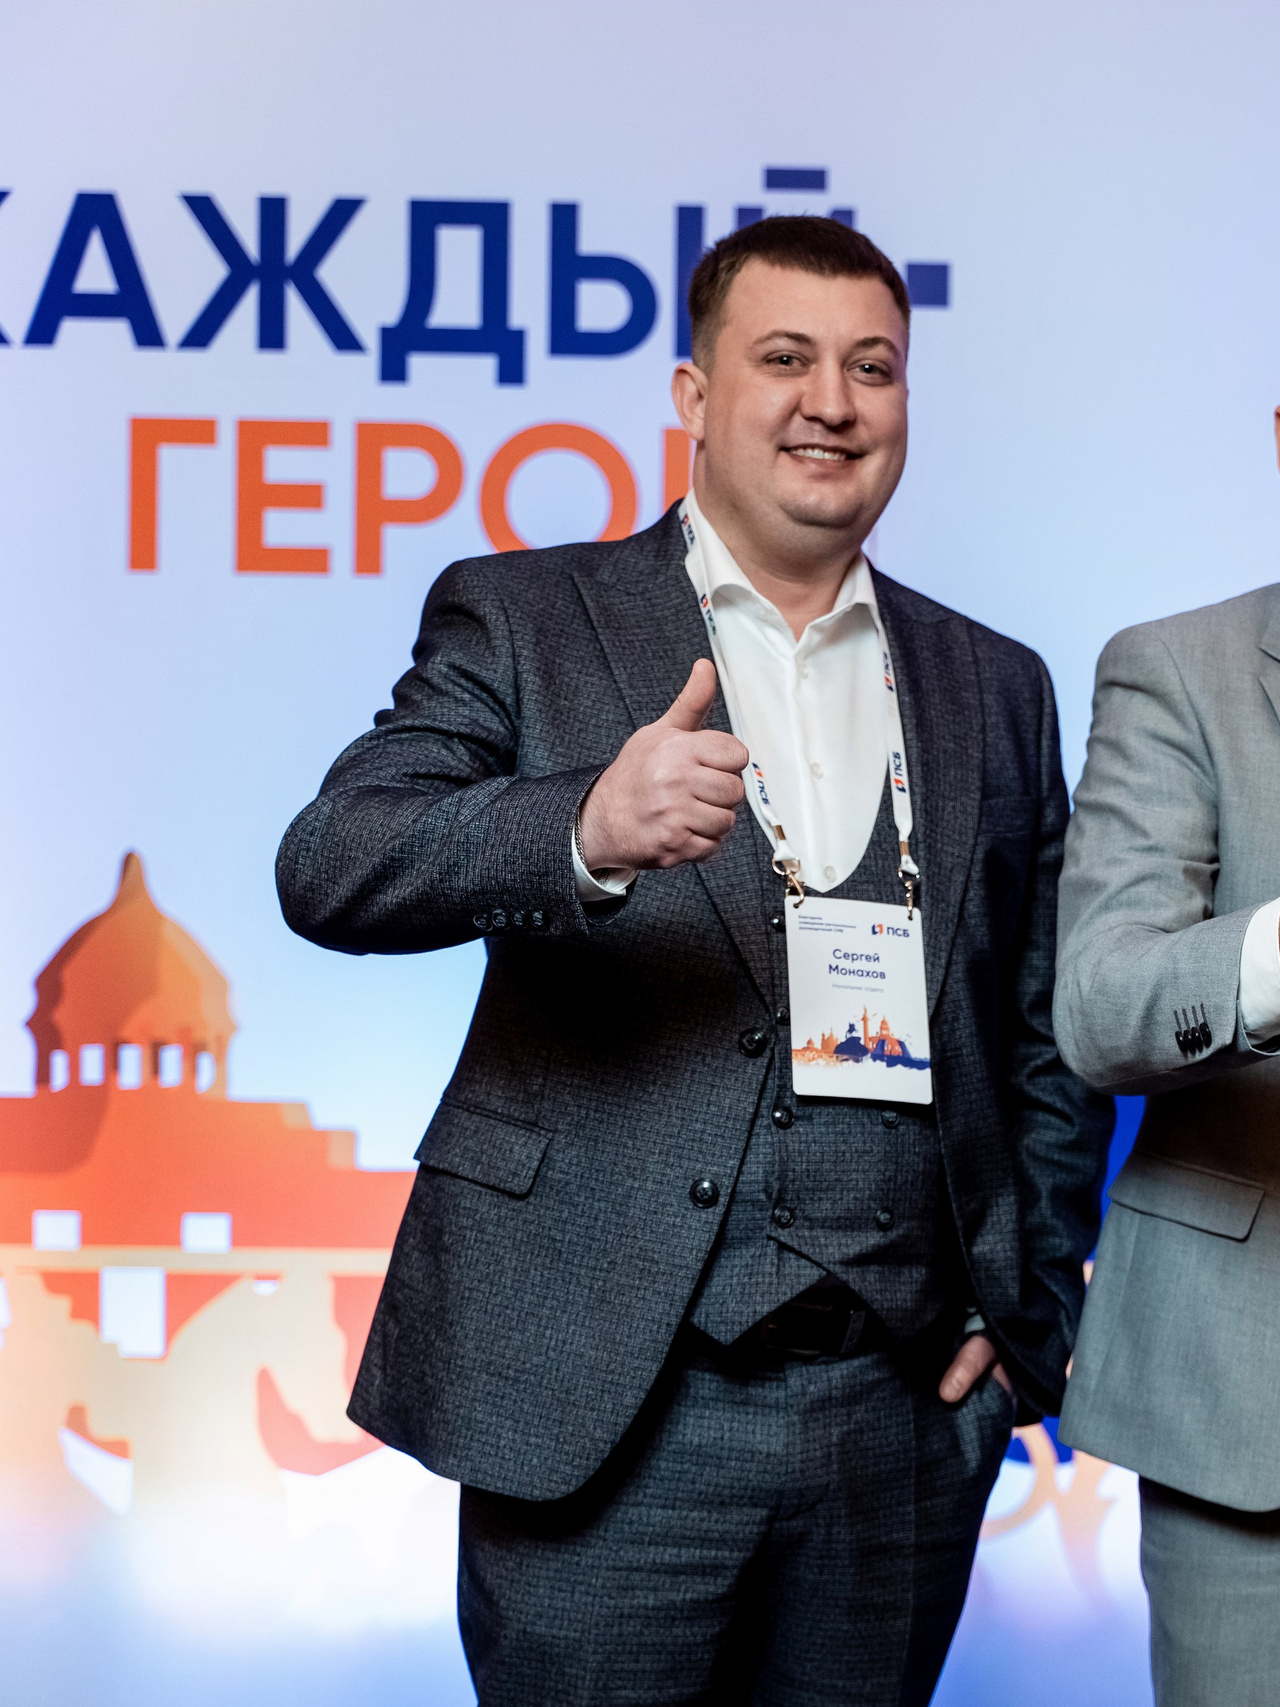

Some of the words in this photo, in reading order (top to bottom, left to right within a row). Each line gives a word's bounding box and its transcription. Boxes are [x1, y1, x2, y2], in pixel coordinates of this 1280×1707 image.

[0, 167, 858, 386] АЖДЫ
[128, 416, 694, 576] ГЕРО
[892, 751, 903, 777] ПСБ
[757, 779, 770, 806] ПСБ
[886, 926, 910, 938] ПСБ
[832, 948, 880, 963] Сергей
[828, 963, 886, 980] Монахов
